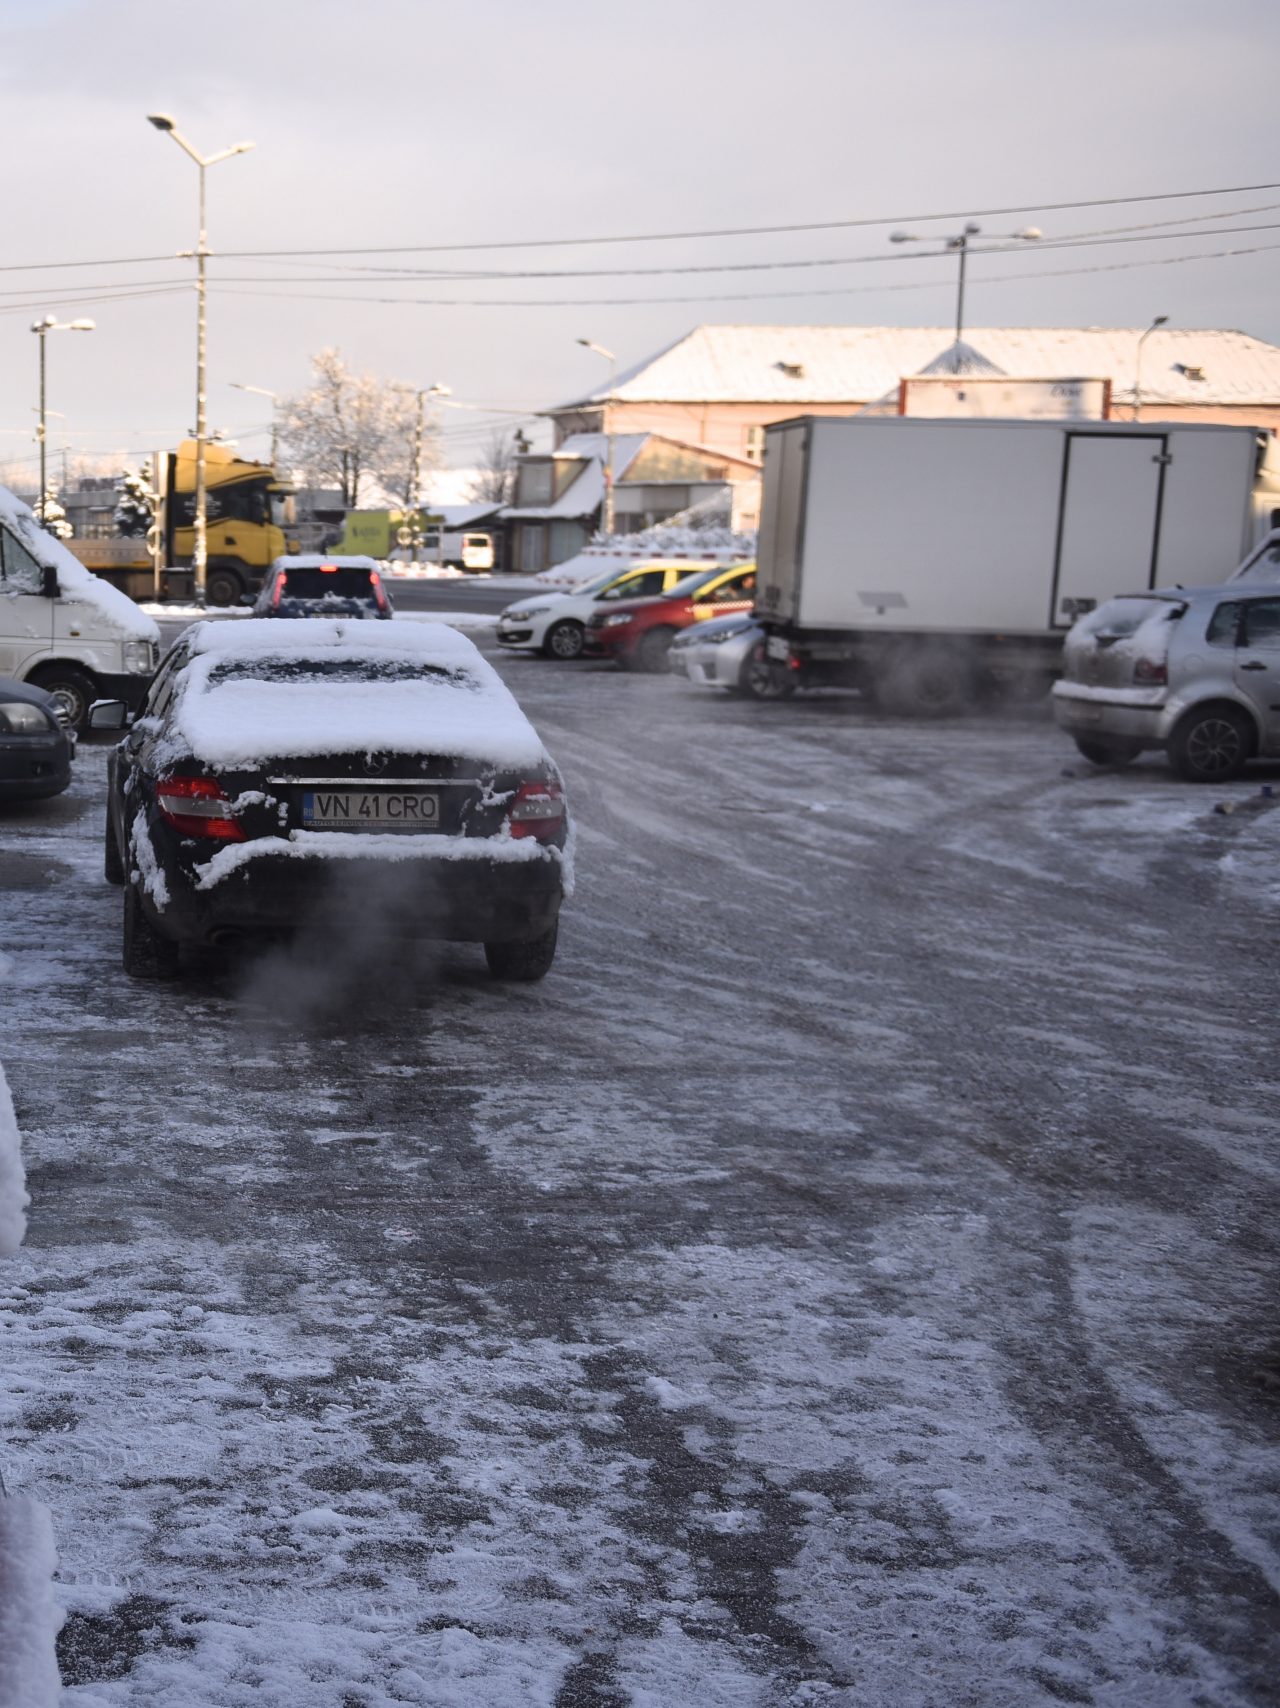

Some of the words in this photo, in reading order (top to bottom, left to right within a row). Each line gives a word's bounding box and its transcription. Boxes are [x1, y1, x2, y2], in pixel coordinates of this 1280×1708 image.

[317, 795, 350, 817] VN
[358, 795, 380, 817] 41
[386, 796, 436, 818] CRO
